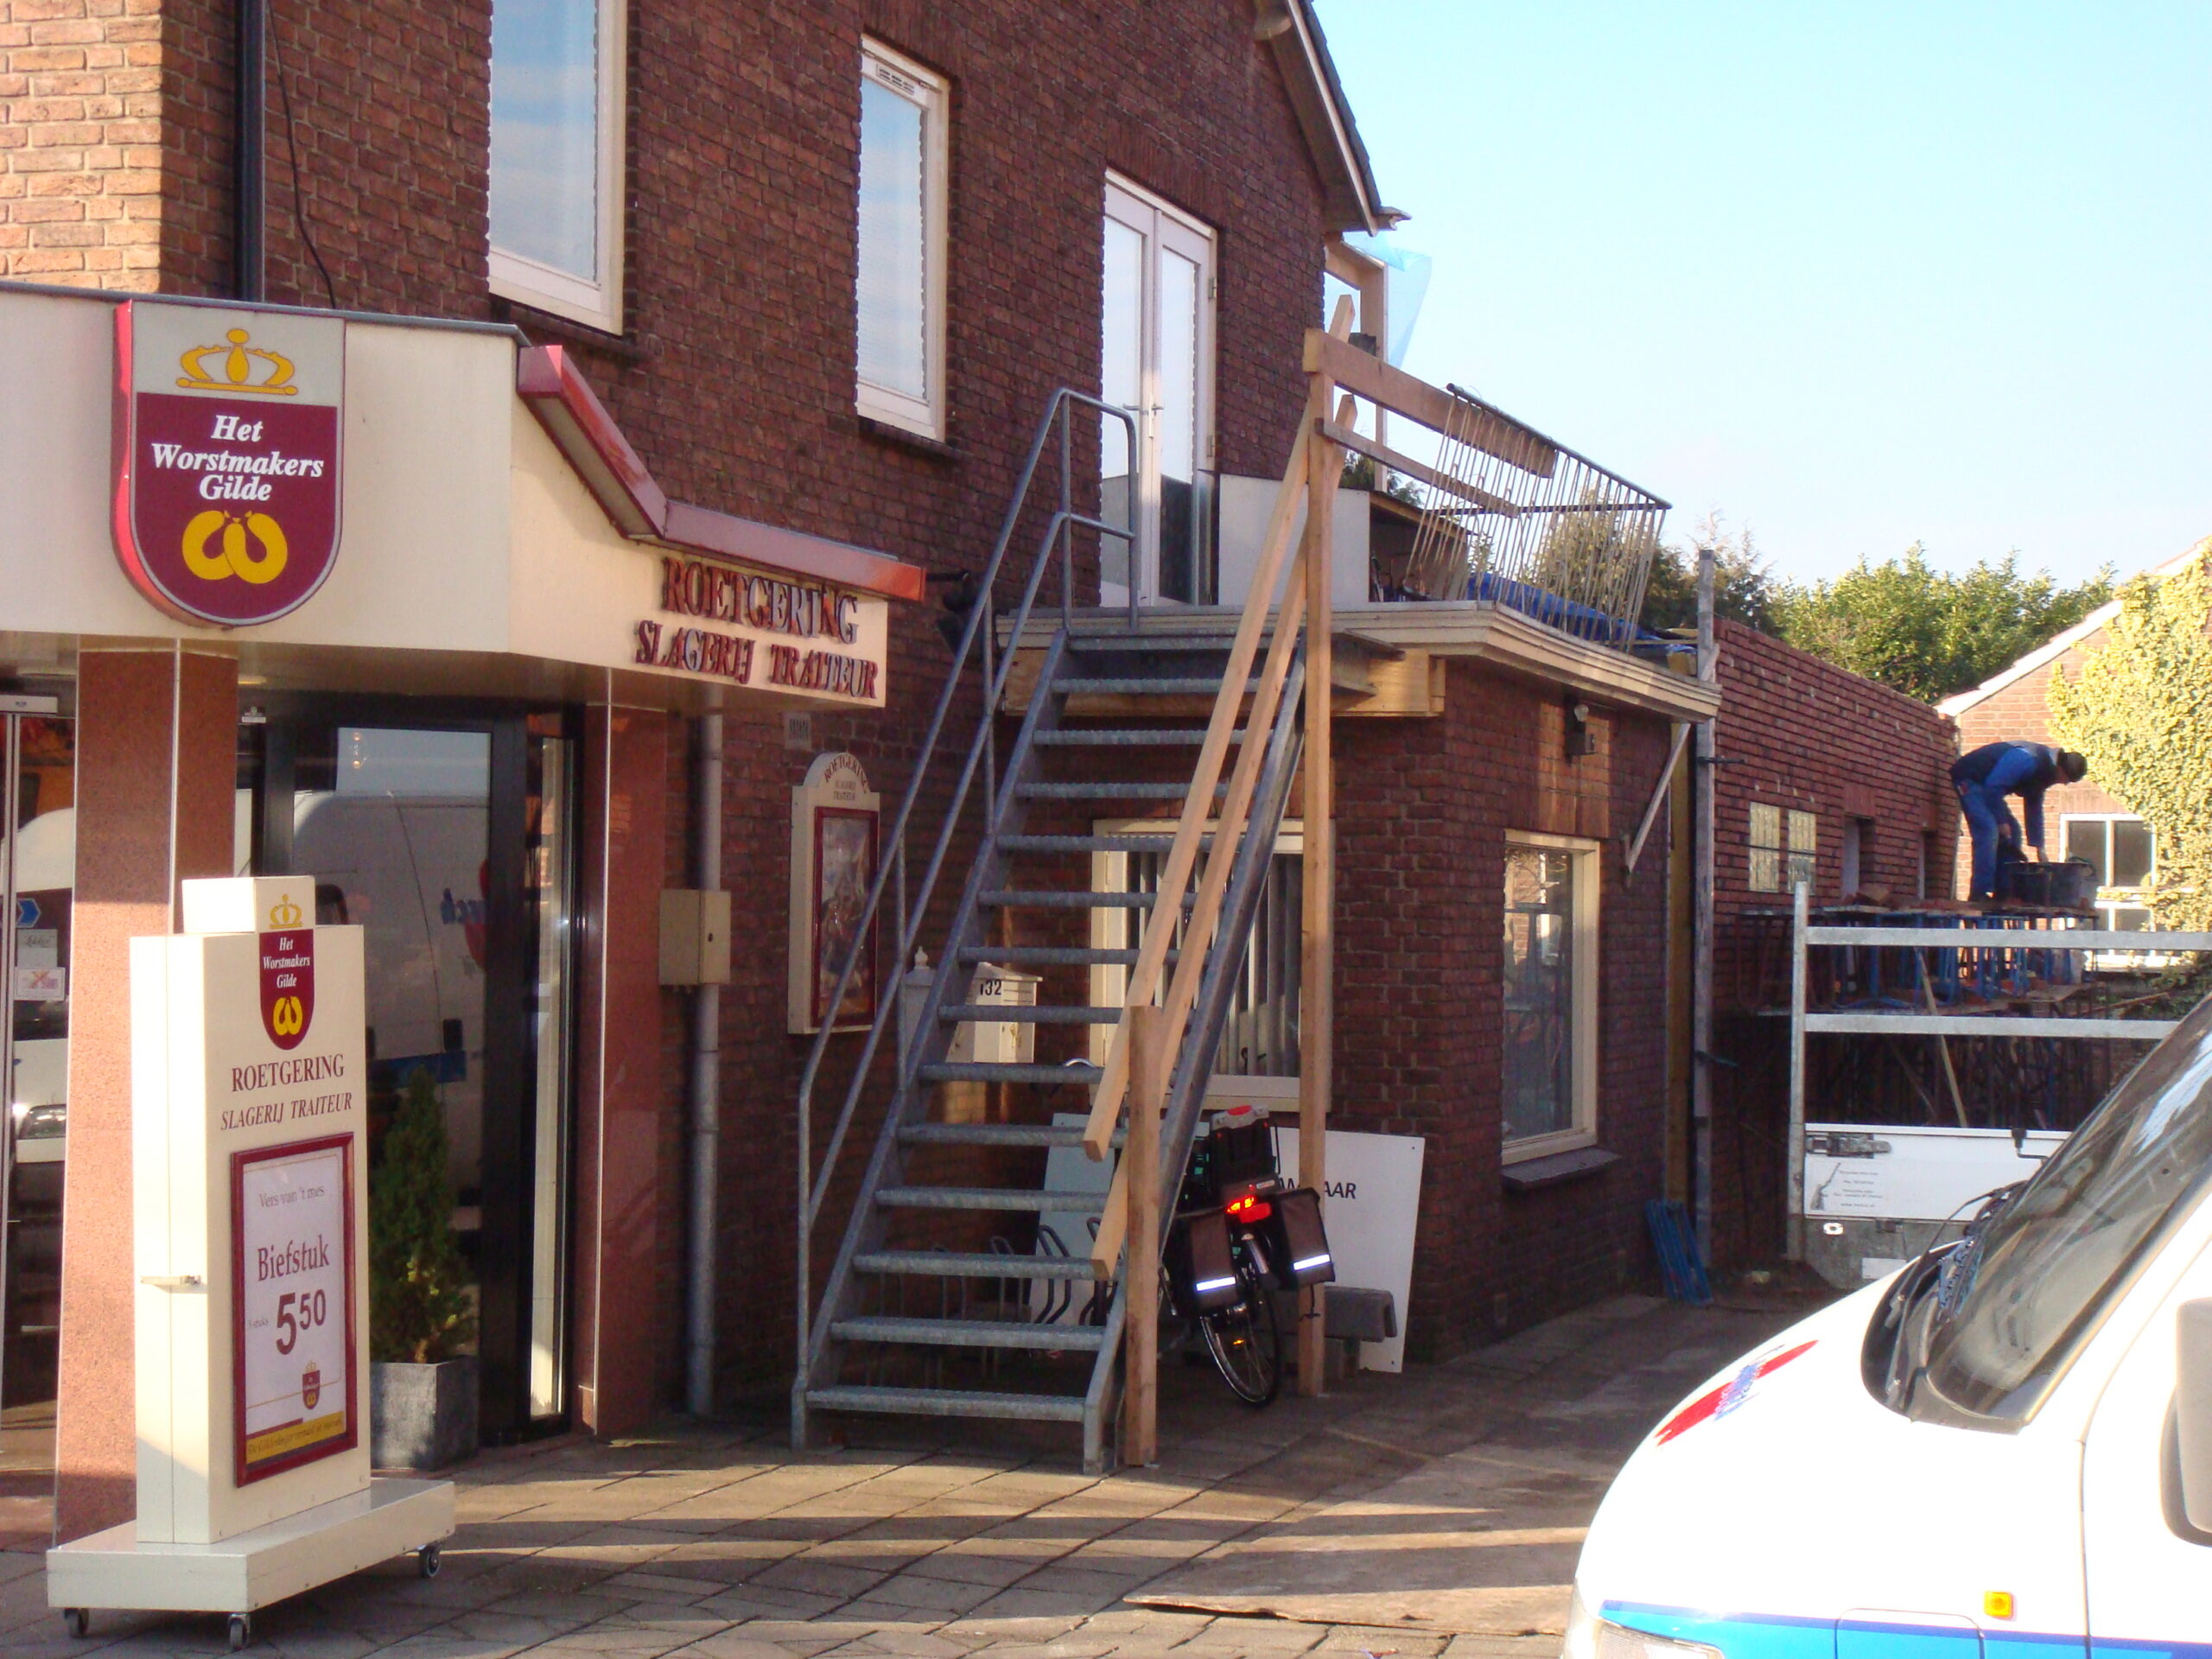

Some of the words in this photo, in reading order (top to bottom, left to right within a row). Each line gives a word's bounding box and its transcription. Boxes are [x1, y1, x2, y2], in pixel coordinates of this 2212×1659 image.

[210, 415, 264, 442] Het
[151, 442, 324, 478] Worstmakers
[200, 474, 272, 501] Gilde
[663, 556, 860, 645] ROETGERING
[635, 620, 756, 685] SLAGERIJ
[769, 643, 879, 699] TRAITEUR
[279, 937, 294, 951] Het
[263, 953, 310, 969] Worstmakers
[276, 974, 297, 989] Gilde
[980, 979, 1002, 995] 132
[232, 1053, 345, 1092] ROETGERING
[220, 1103, 284, 1131] SLAGERIJ
[290, 1091, 353, 1121] TRAITEUR
[259, 1193, 279, 1207] Vers
[257, 1234, 330, 1281] Biefstuk
